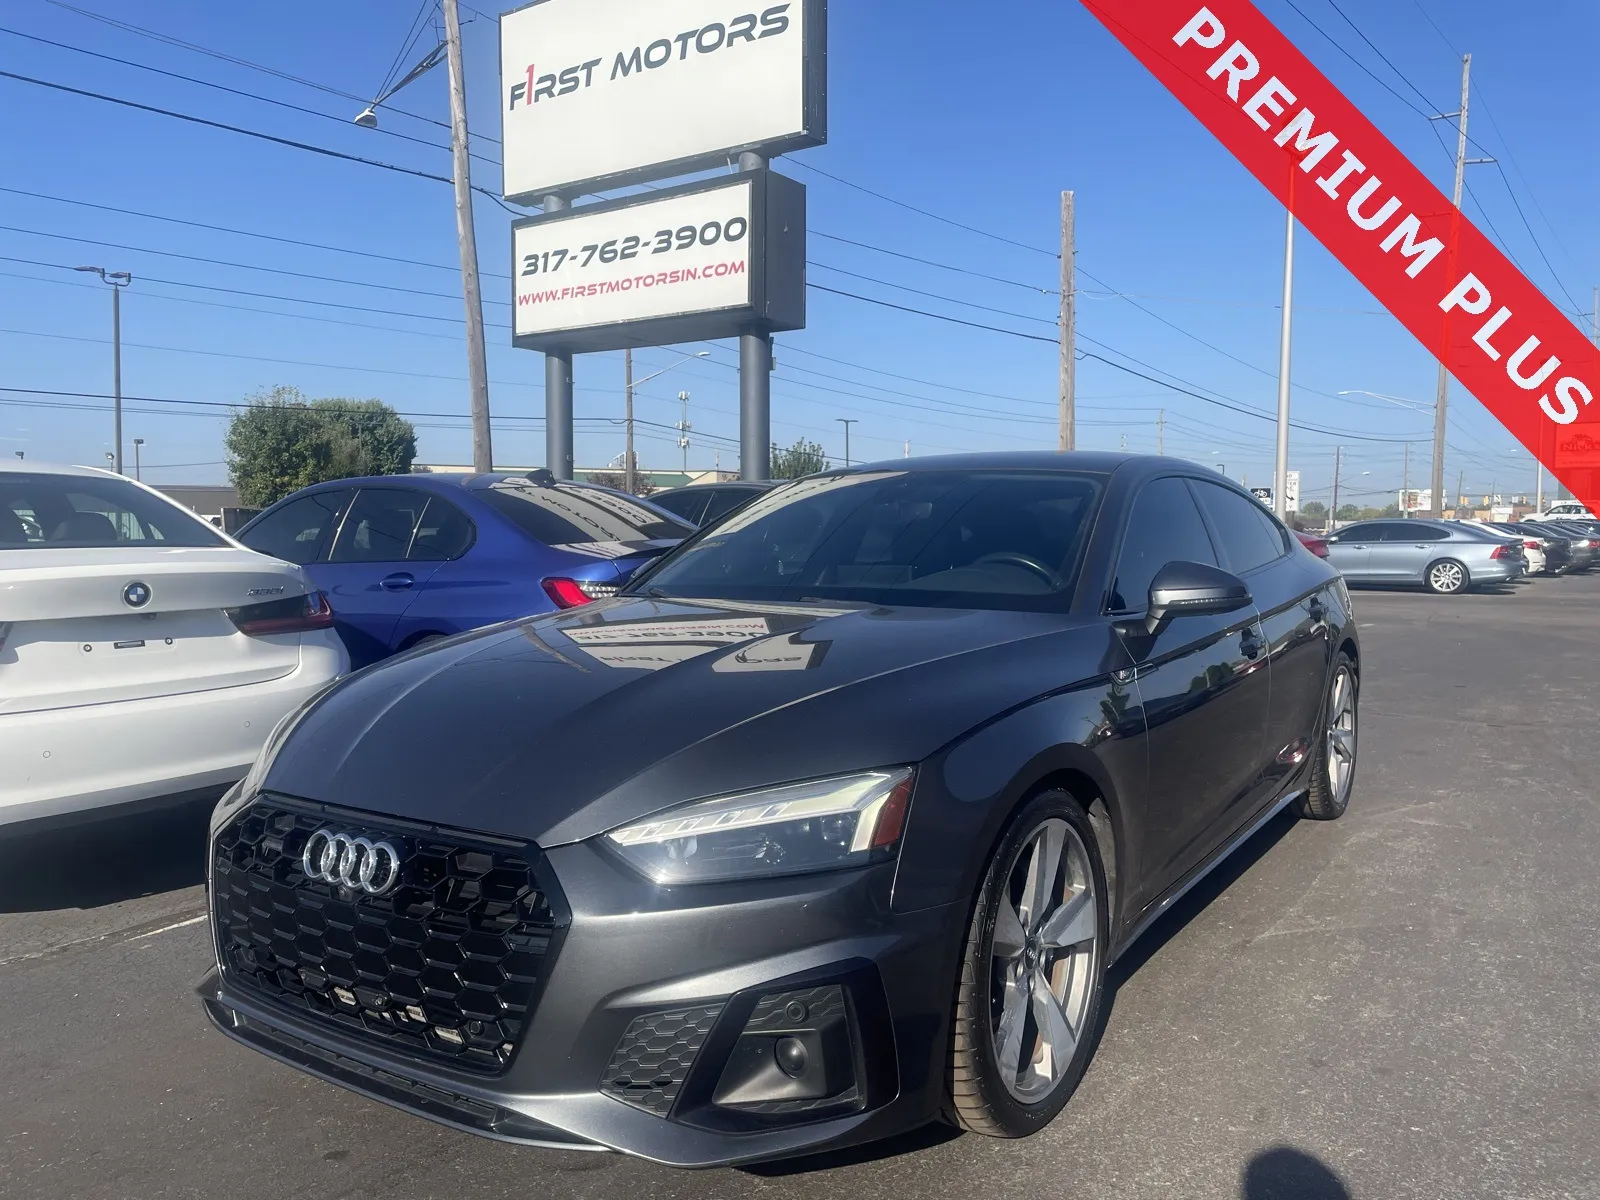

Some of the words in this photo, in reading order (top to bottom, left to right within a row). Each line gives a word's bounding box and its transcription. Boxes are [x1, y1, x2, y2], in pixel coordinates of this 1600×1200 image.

[610, 3, 791, 80] MOTORS
[520, 216, 748, 277] 317-762-3900
[518, 260, 745, 306] WWW.FIRSTMOTORSIN.COM
